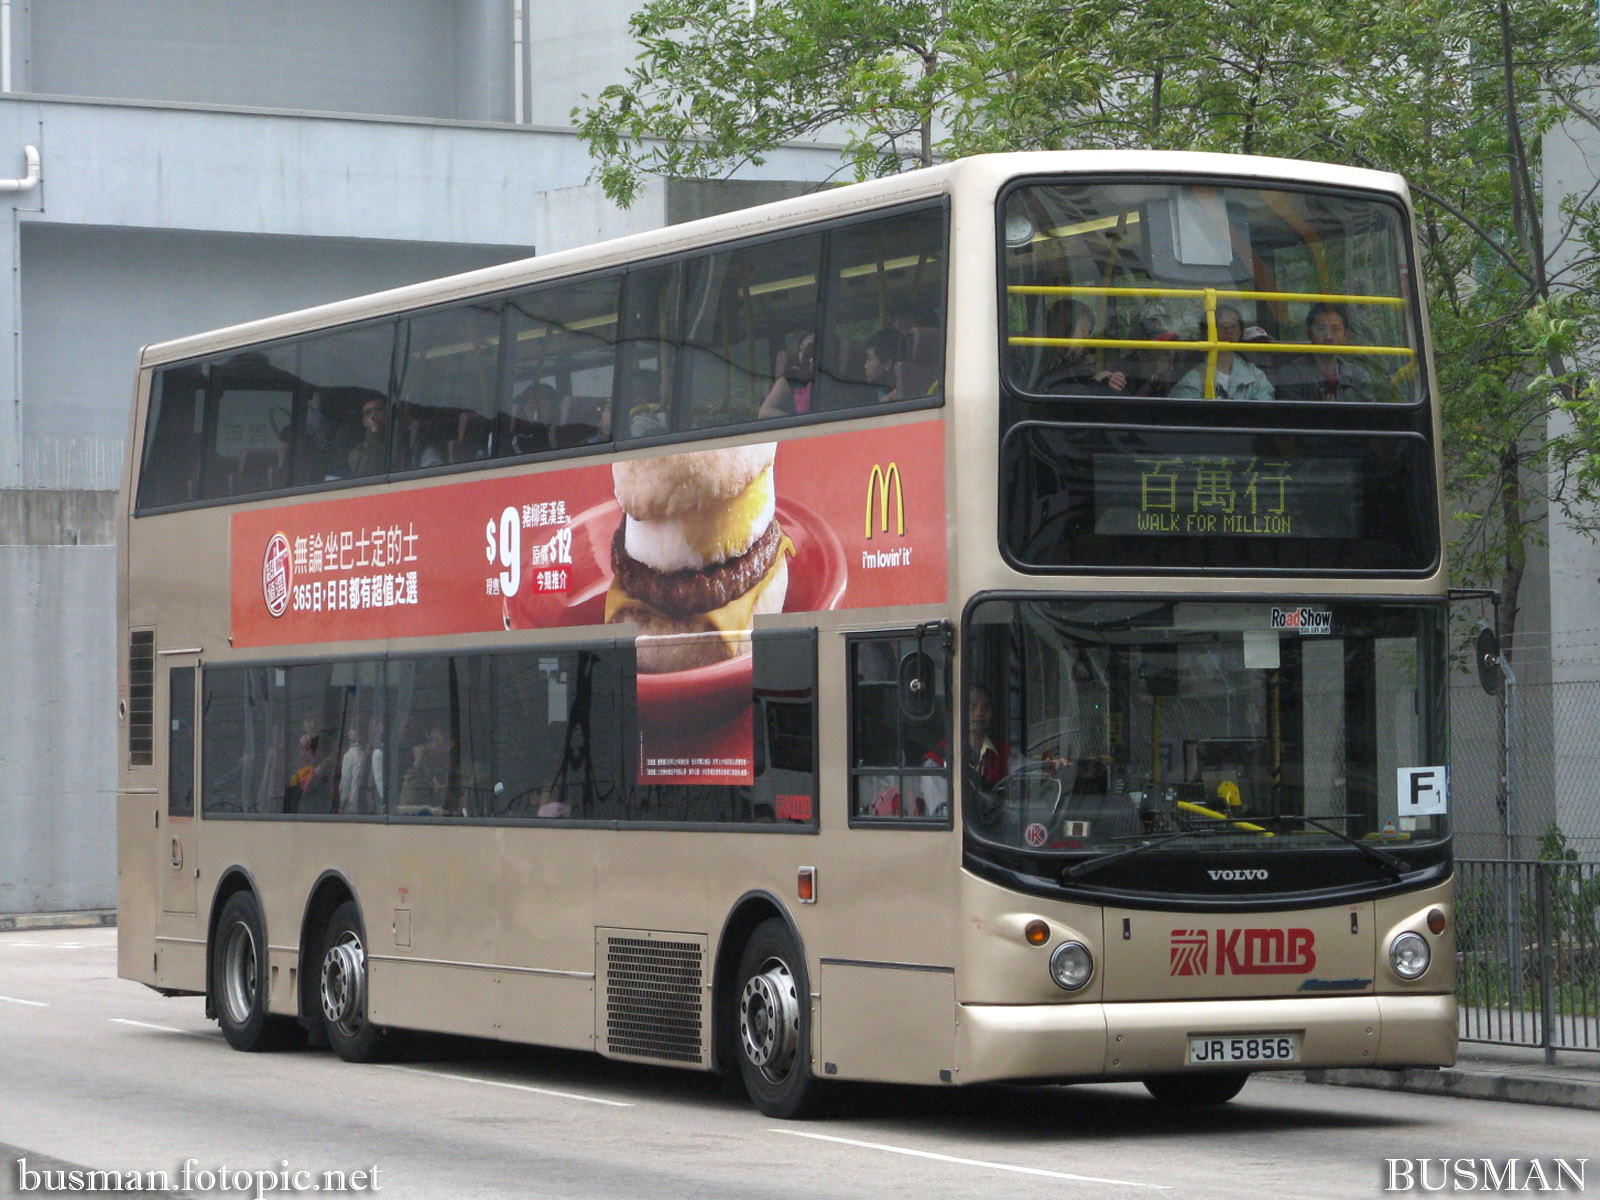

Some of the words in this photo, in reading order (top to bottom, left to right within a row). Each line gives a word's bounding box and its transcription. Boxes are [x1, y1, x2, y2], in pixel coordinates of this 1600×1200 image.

[1134, 456, 1293, 514] 百萬行
[1137, 513, 1180, 532] WALK
[1187, 514, 1217, 532] FOR
[1223, 515, 1293, 533] MILLION
[294, 522, 418, 575] 無論坐巴士定的士
[486, 506, 520, 597] $9
[862, 551, 876, 569] i'm
[877, 548, 902, 568] lovin'
[903, 547, 911, 566] it
[1271, 607, 1332, 628] RoadShow
[1410, 772, 1434, 804] F
[1207, 869, 1269, 881] VOLVO
[1215, 927, 1317, 975] KMB
[1195, 1041, 1224, 1061] JR
[1230, 1039, 1290, 1060] 5856
